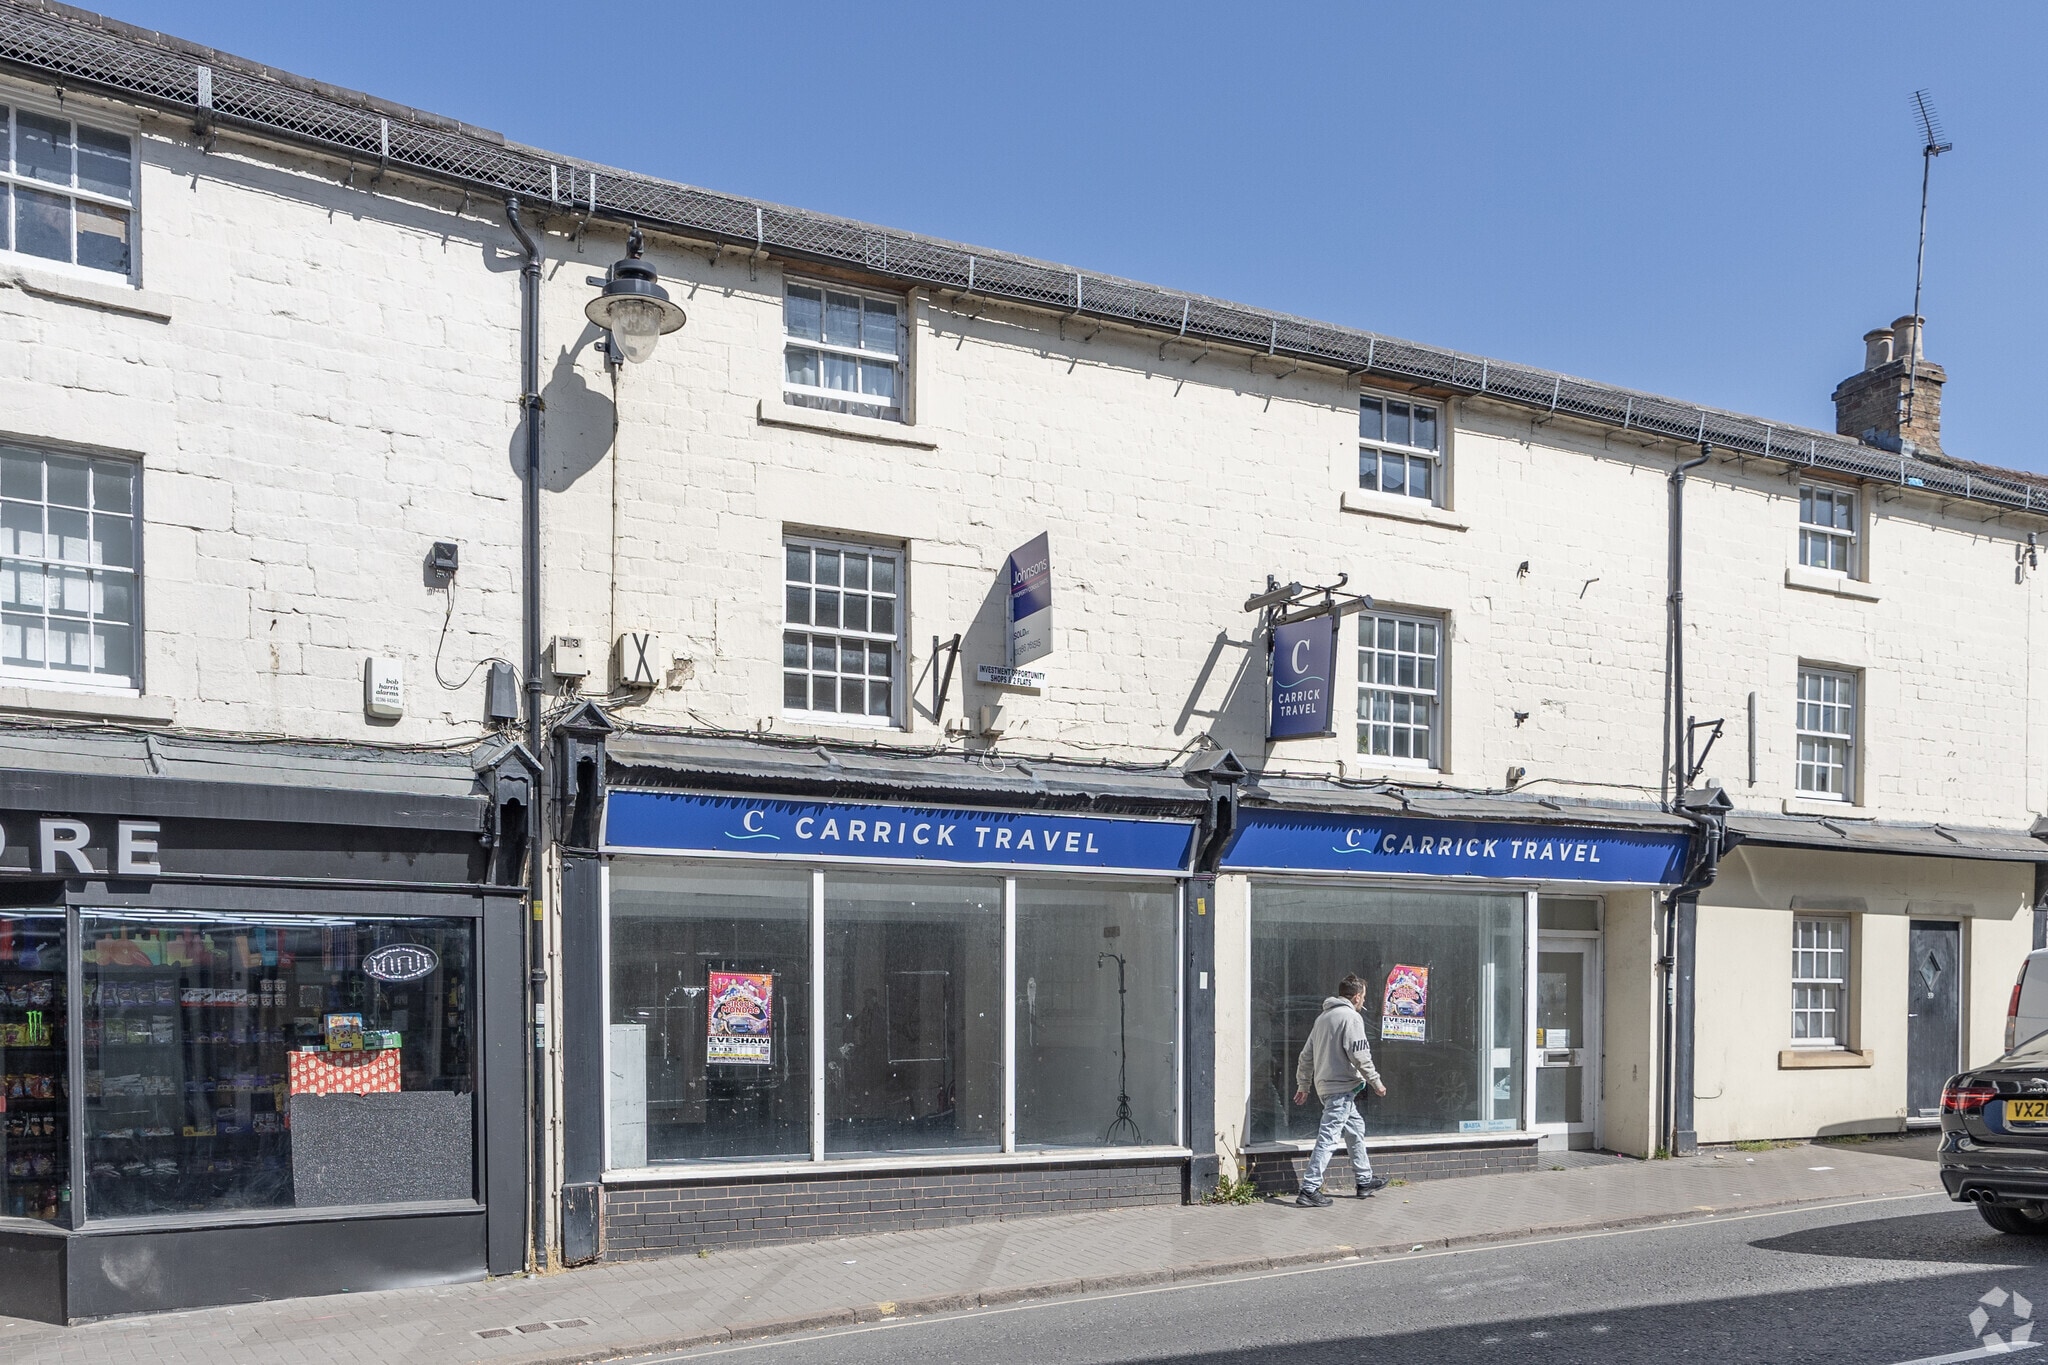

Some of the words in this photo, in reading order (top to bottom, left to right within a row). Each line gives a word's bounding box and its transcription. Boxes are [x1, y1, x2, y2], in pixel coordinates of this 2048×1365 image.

[1013, 558, 1048, 586] Johnsons
[1013, 628, 1026, 641] SOLD
[1291, 638, 1311, 675] C
[979, 664, 1011, 676] INVESTMENT
[1011, 668, 1046, 681] OPPORTUNITY
[378, 683, 399, 691] harris
[385, 677, 399, 685] bob
[990, 674, 1007, 684] SHOPS
[1017, 677, 1032, 687] FLATS
[375, 689, 399, 697] alarms
[1278, 688, 1321, 704] CARRICK
[1280, 703, 1317, 717] TRAVEL
[743, 810, 765, 833] C
[795, 816, 957, 847] CARRICK
[975, 826, 1099, 854] TRAVEL
[0, 817, 161, 876] RE
[1345, 828, 1363, 848] C
[1382, 833, 1500, 859] CARRICK
[1511, 839, 1601, 864] TRAVEL
[1383, 1016, 1425, 1025] EVESHAM
